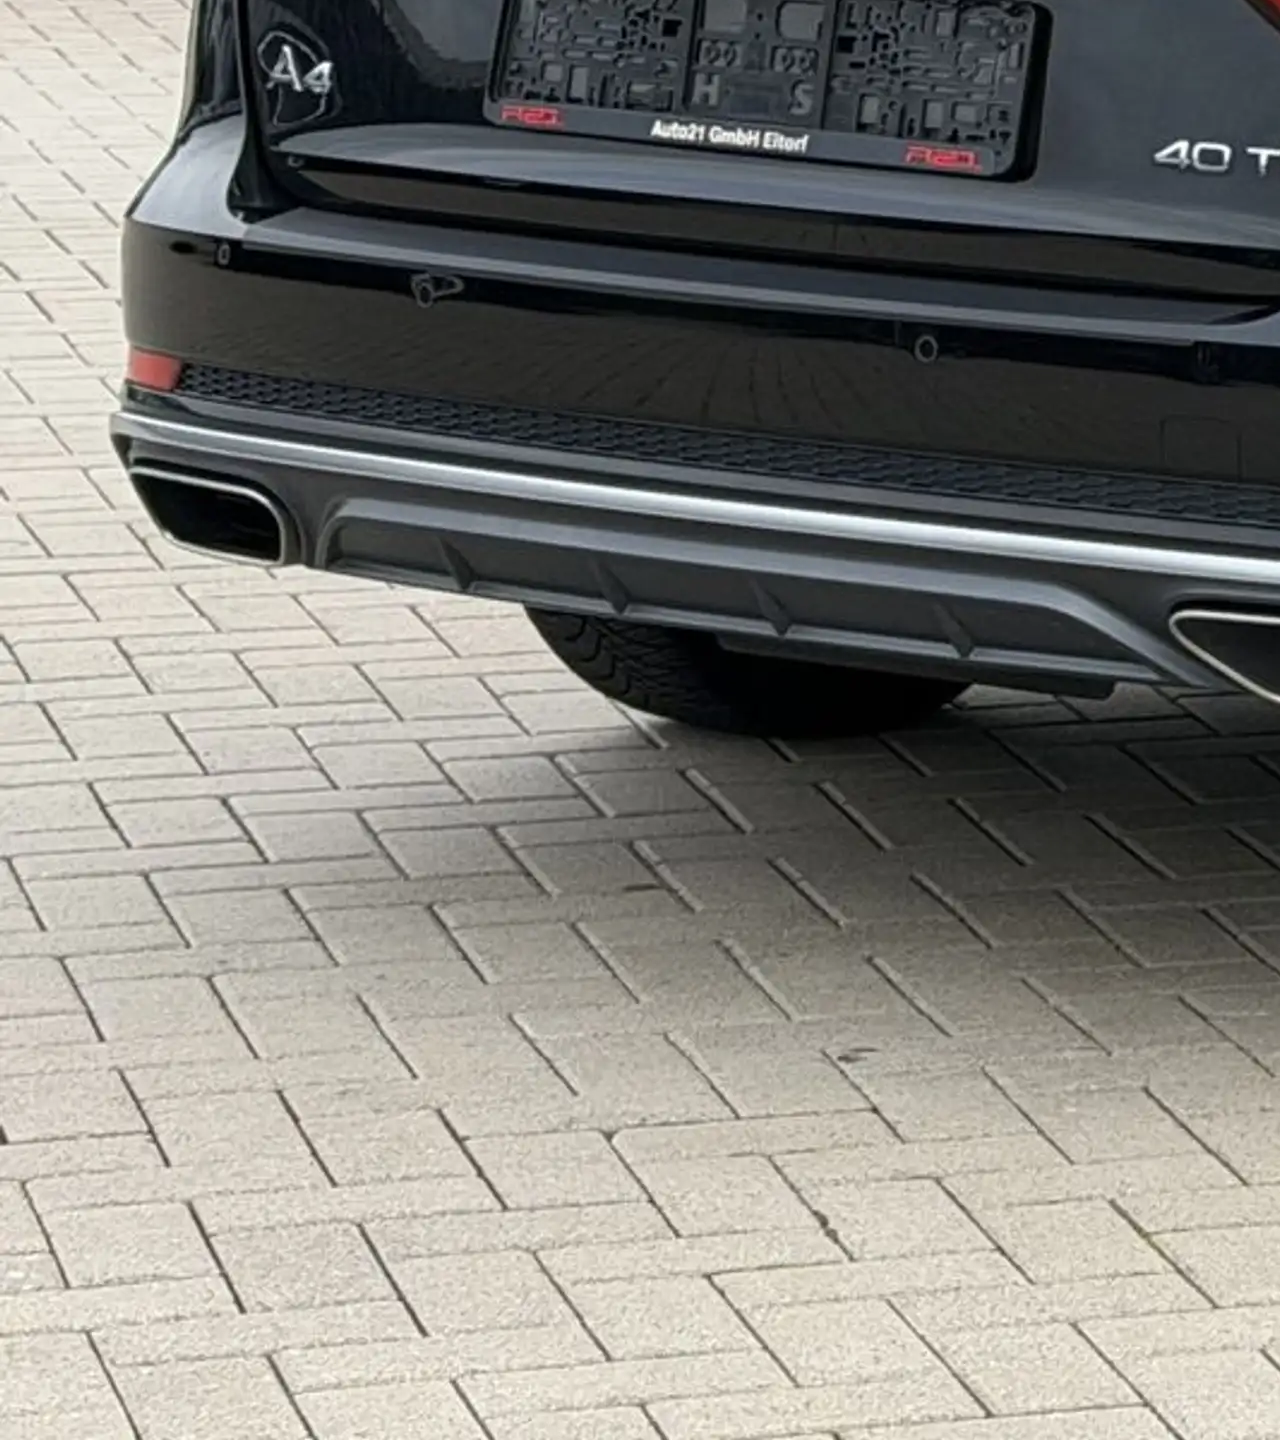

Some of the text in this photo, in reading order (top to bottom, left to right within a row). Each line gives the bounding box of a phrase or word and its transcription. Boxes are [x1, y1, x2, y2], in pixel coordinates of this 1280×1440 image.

[264, 44, 334, 95] A4
[650, 118, 811, 154] Auto21 GmbH Eitorf
[1153, 139, 1233, 173] 40
